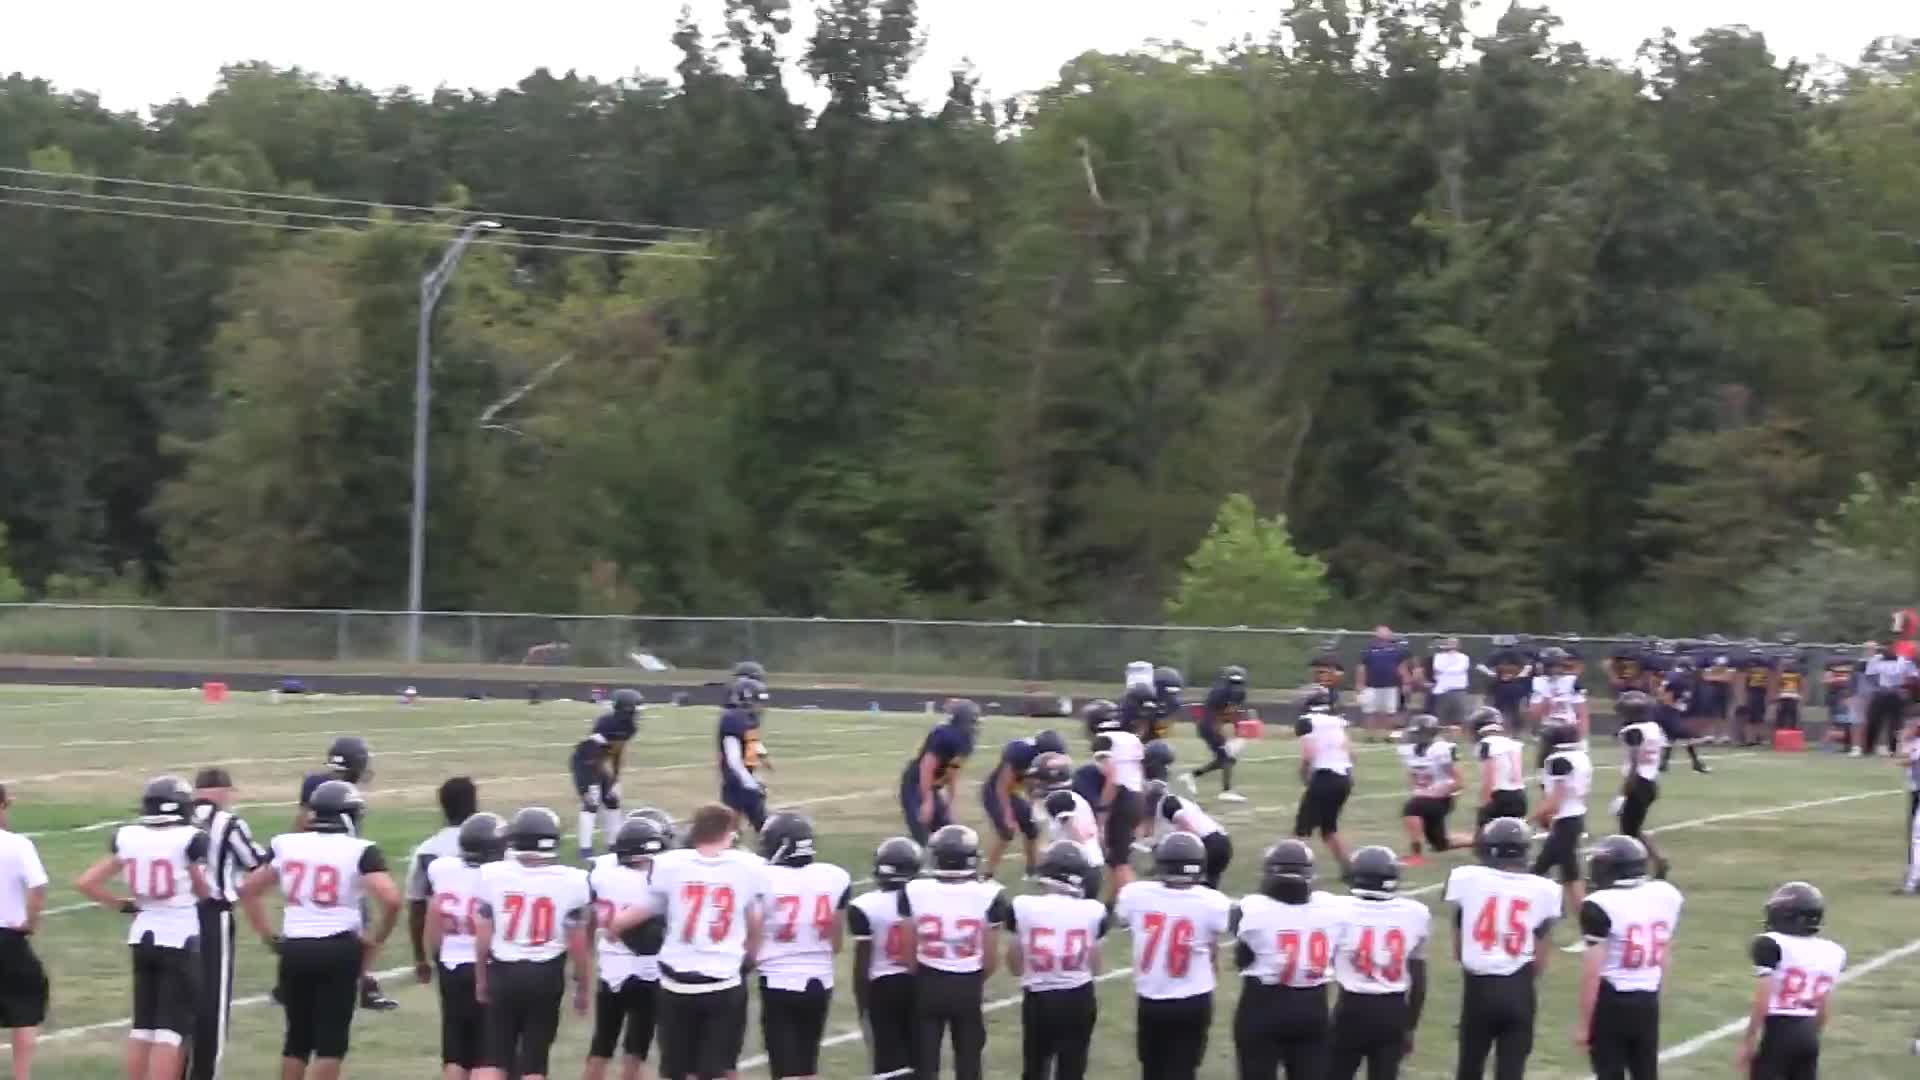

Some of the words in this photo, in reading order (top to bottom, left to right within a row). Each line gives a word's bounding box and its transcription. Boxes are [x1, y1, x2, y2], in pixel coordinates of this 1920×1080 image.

[283, 861, 338, 907] 78
[502, 892, 555, 945] 70
[681, 881, 735, 943] 73
[917, 914, 984, 959] 23
[1473, 896, 1529, 956] 45
[1029, 927, 1088, 972] 50
[1140, 912, 1194, 977] 76
[1277, 929, 1329, 983] 79
[1352, 926, 1405, 982] 43
